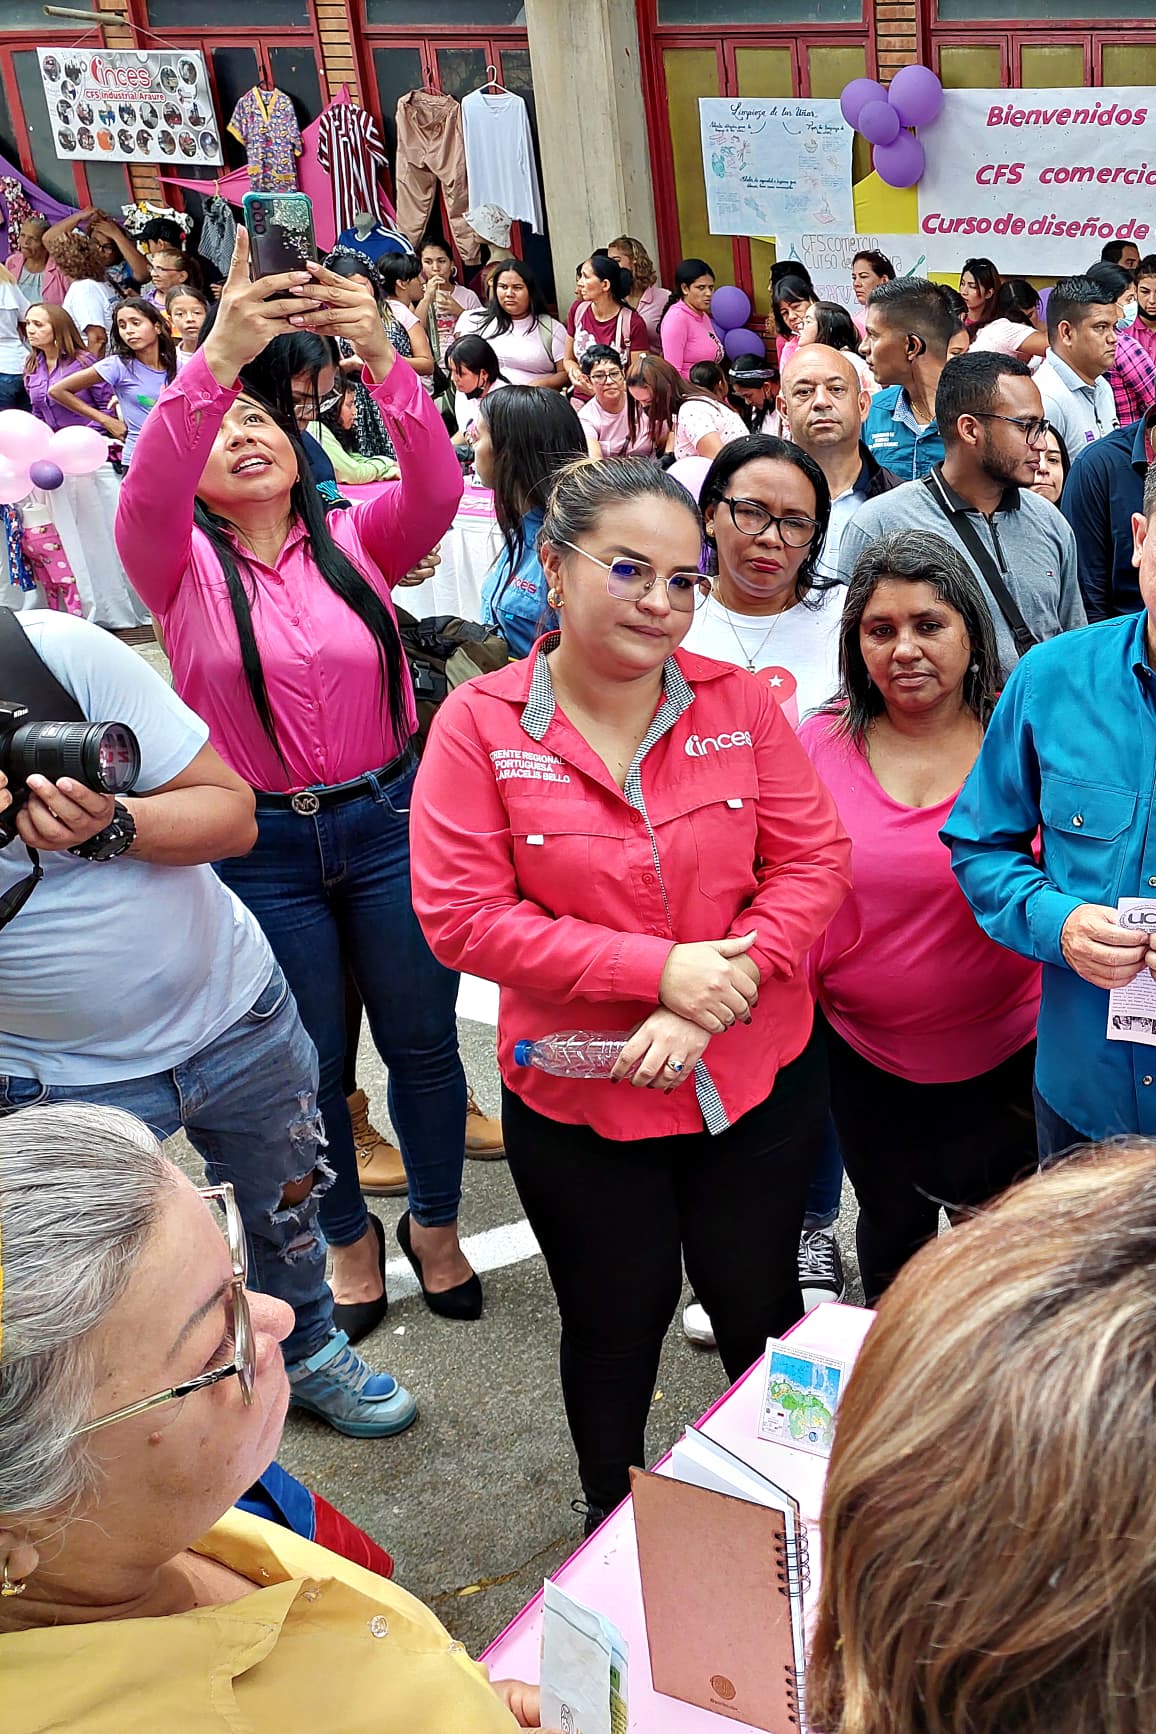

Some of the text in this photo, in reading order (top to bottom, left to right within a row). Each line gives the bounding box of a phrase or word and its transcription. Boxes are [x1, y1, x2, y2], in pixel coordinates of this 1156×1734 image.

[91, 55, 151, 87] inces
[986, 101, 1147, 127] Bienvenidos
[975, 163, 1025, 186] CFS
[921, 213, 991, 235] Curso
[992, 213, 1025, 235] de
[1028, 214, 1113, 238] diseño
[1115, 218, 1148, 240] de
[801, 234, 826, 252] CFS
[685, 730, 753, 757] inces
[494, 759, 553, 773] PORTUGUESA
[522, 751, 565, 765] REGIONAL
[542, 772, 571, 784] BELLO
